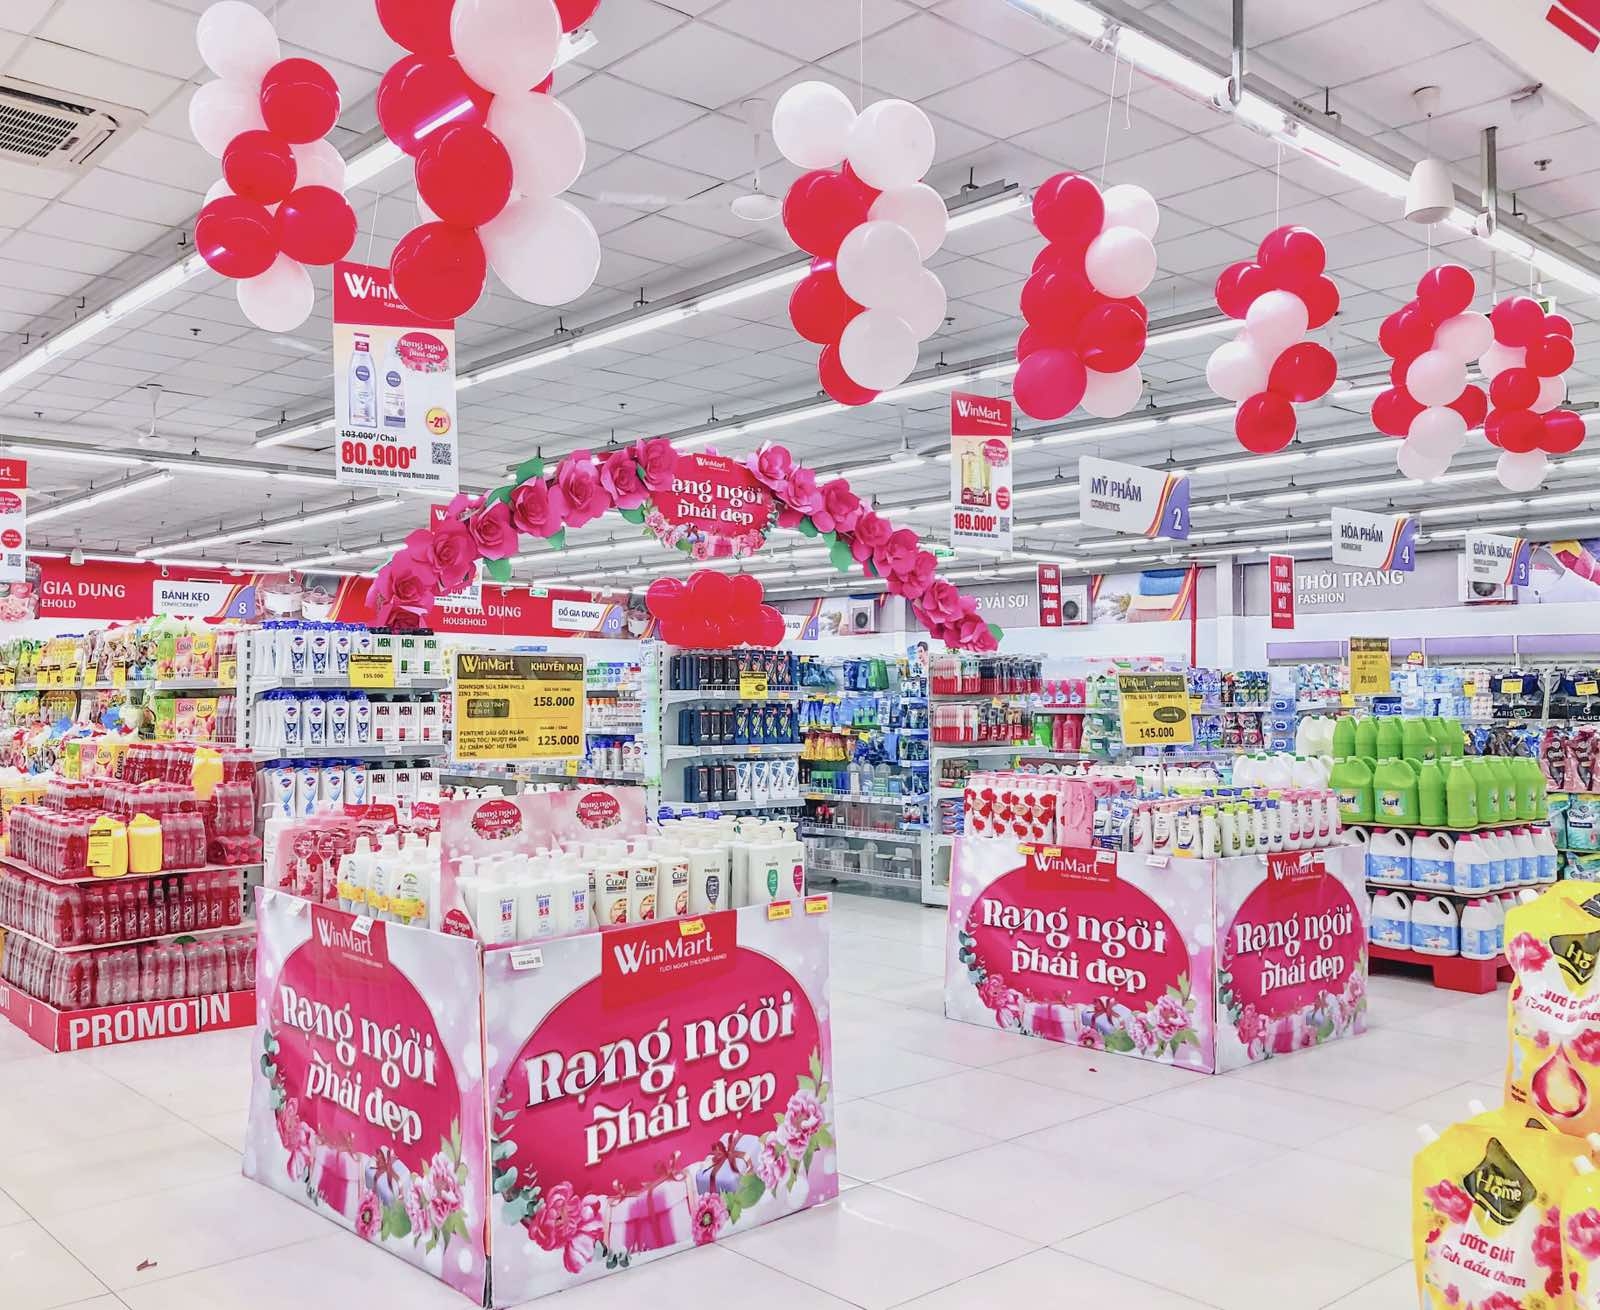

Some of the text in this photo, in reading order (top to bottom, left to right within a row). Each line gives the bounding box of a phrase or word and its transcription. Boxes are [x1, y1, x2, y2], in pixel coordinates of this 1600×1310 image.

[956, 399, 1001, 420] WinMart
[341, 440, 417, 470] 80.900đ
[677, 498, 754, 525] phái đẹp
[1173, 507, 1182, 530] 2
[1401, 546, 1410, 563] 4
[1519, 563, 1526, 580] 3
[1273, 582, 1291, 593] TRANG
[1297, 570, 1404, 590] THỜI TRANG
[43, 580, 126, 598] GIA DỤNG
[161, 589, 189, 600] BÁNH
[985, 593, 1005, 609] VẢI
[1297, 592, 1344, 604] FASHION
[239, 602, 246, 614] 8
[569, 609, 581, 617] GIA
[443, 617, 487, 626] HOUSEHOLD
[608, 619, 619, 630] 10
[808, 628, 817, 637] 11
[377, 638, 391, 648] MEN
[401, 639, 414, 648] MEN
[424, 640, 437, 649] MEN
[462, 655, 515, 673] WinMart
[533, 697, 575, 707] 158.000
[376, 706, 390, 715] MEN
[399, 706, 412, 716] MEN
[423, 706, 436, 715] MEN
[538, 735, 579, 746] 125.000
[1140, 727, 1174, 738] 145.000
[372, 774, 386, 784] MEN
[396, 773, 410, 782] MEN
[420, 772, 433, 781] MEN
[1382, 797, 1399, 806] Surf
[1034, 852, 1099, 875] WinMart
[316, 916, 374, 956] WinMart
[982, 898, 1167, 959] Rạng ngời
[1235, 903, 1352, 958] Rạng ngời
[613, 931, 713, 975] WinMart
[1010, 939, 1147, 993] phái đẹp
[1261, 954, 1344, 996] phái đẹp
[281, 984, 437, 1088] Rạng ngời
[525, 989, 796, 1107] Rạng ngời
[305, 1051, 423, 1145] phái đẹp
[584, 1071, 777, 1167] phái đẹp
[1476, 1169, 1521, 1202] Home
